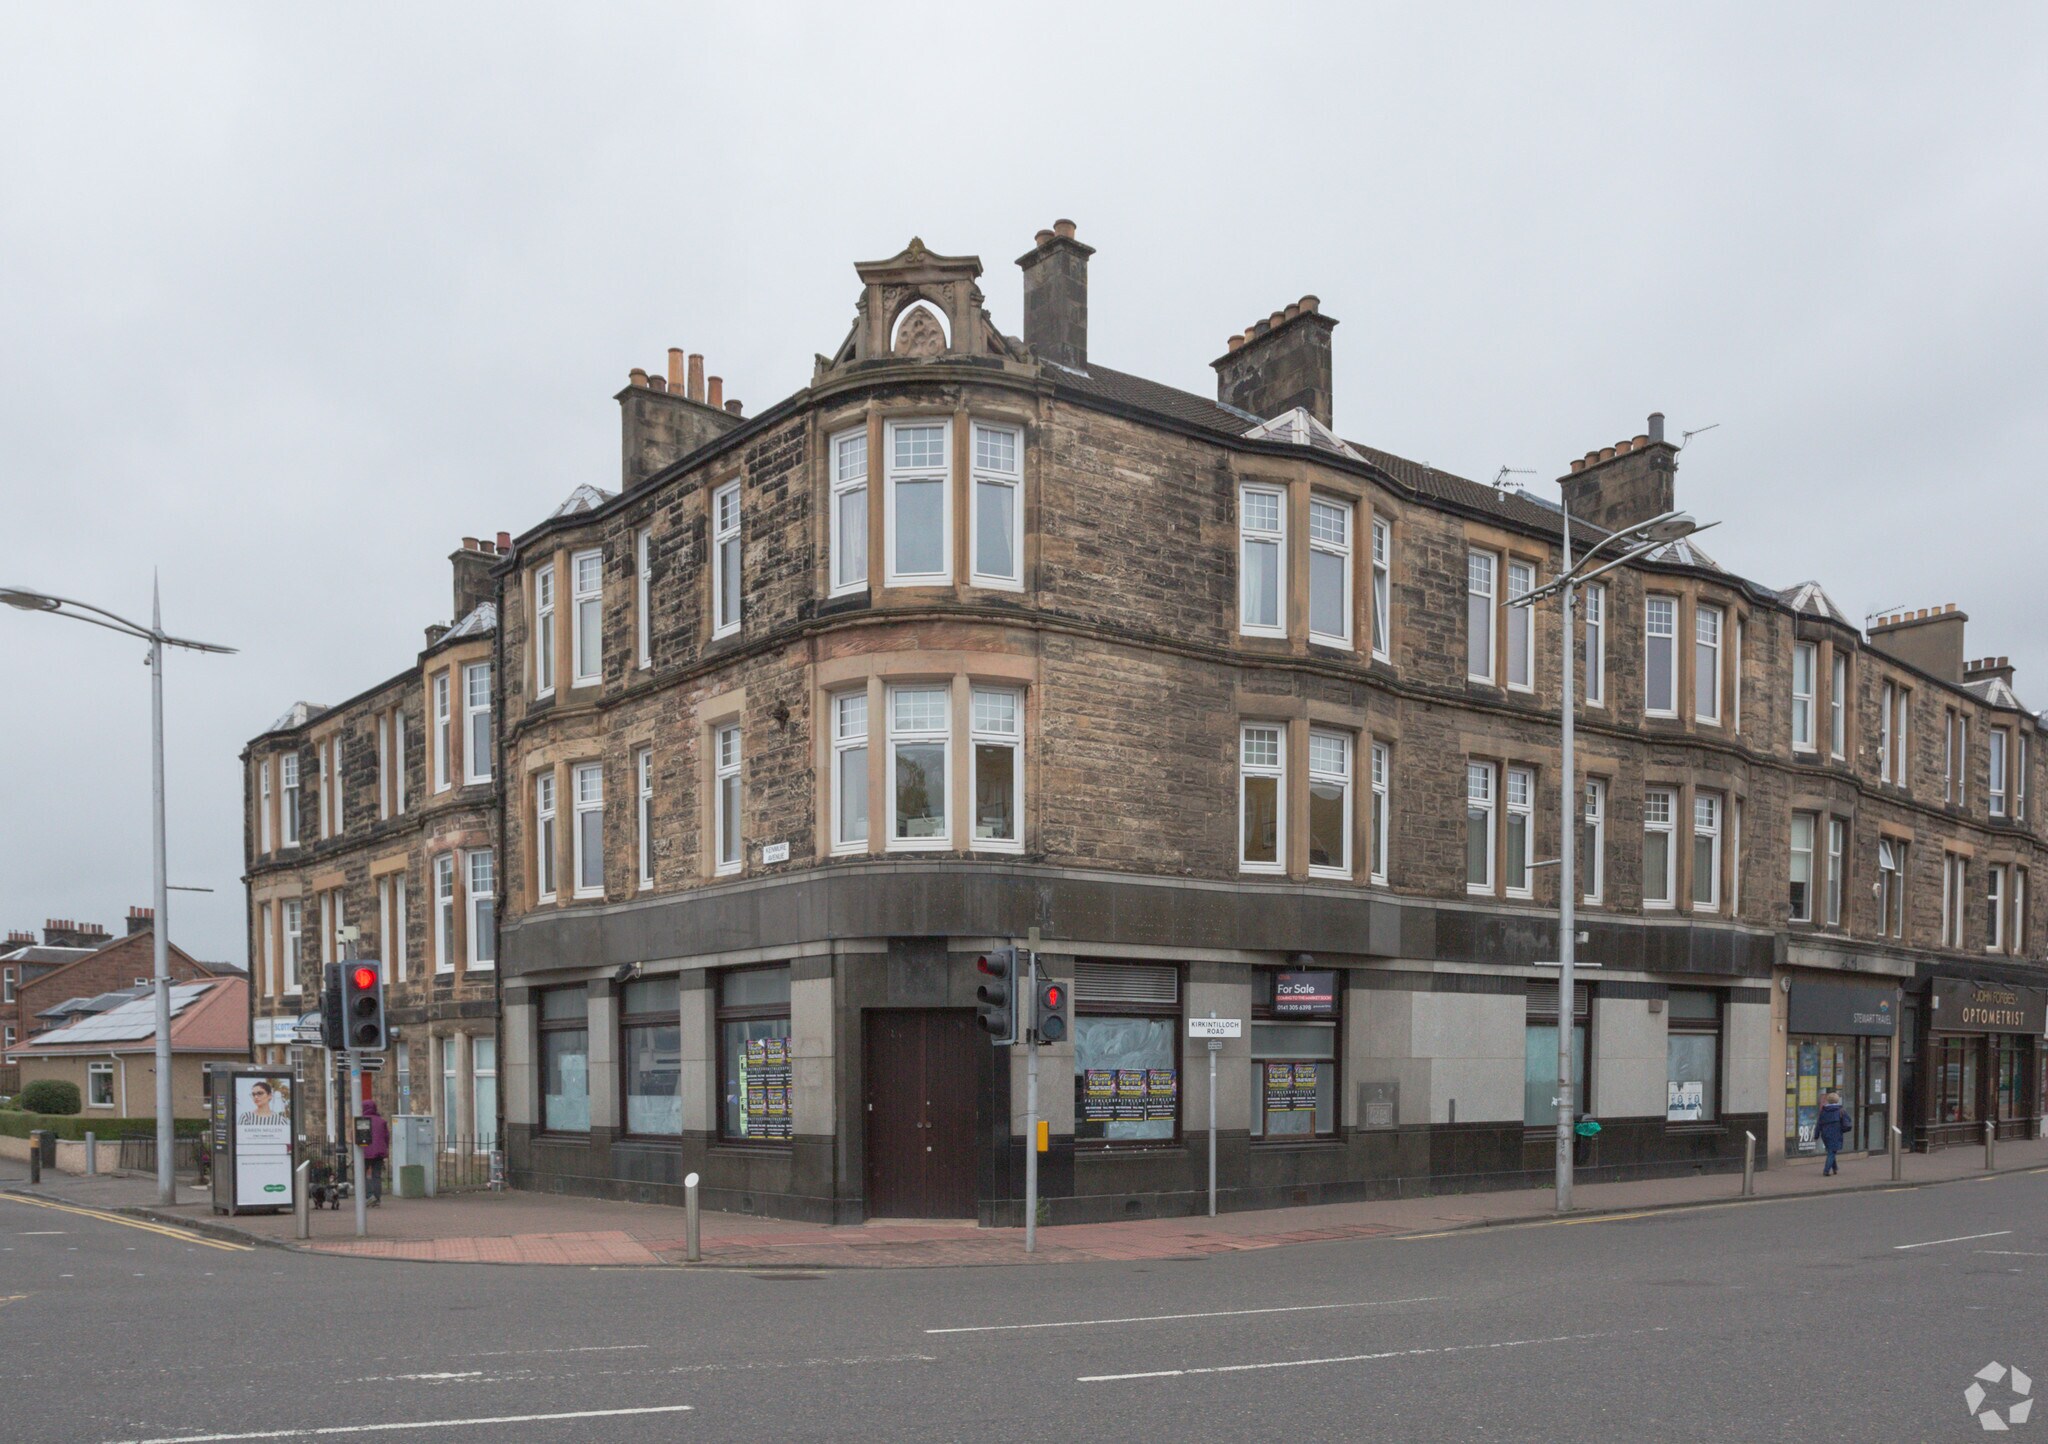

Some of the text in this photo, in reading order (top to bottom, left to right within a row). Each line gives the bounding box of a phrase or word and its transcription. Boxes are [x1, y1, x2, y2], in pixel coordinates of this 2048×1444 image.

[768, 852, 785, 861] AVENUE
[1277, 983, 1315, 994] For Sale
[1976, 990, 1991, 1002] JOHN
[1854, 1013, 1892, 1025] STEWART TRAVEL
[1962, 1007, 2025, 1025] OPTOMETRIST
